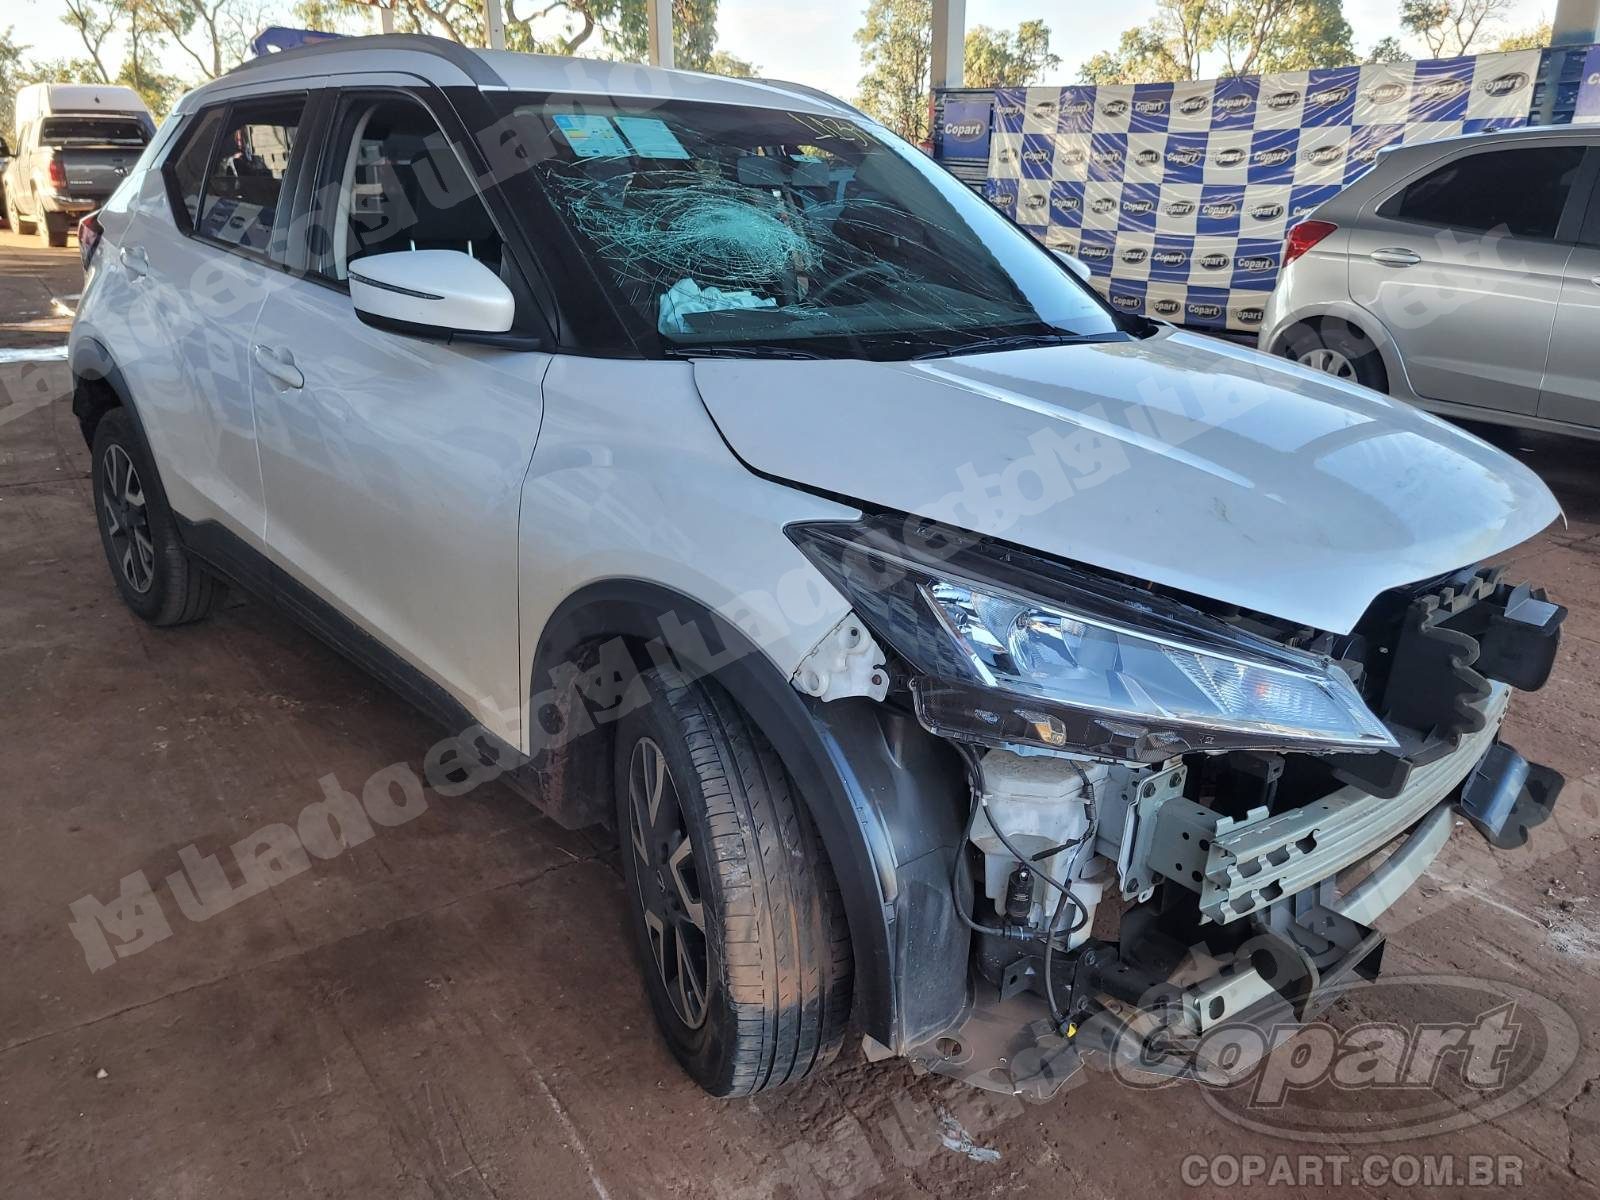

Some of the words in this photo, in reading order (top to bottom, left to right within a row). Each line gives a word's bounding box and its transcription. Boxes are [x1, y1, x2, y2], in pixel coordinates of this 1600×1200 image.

[1477, 77, 1522, 92] Copart
[1062, 103, 1089, 113] Copart
[1135, 102, 1163, 112] Copart
[1217, 97, 1250, 107] Copart
[945, 122, 980, 137] Copart
[1023, 151, 1048, 161] Copart
[1167, 151, 1197, 164] Copart
[1254, 151, 1288, 163] Copart
[1051, 198, 1077, 208] Copart
[1122, 201, 1151, 212] Copart
[1202, 203, 1234, 215] Copart
[1081, 247, 1108, 257] Copart
[1154, 252, 1183, 264] Copart
[1238, 259, 1270, 271] Copart
[1113, 295, 1138, 307] Copart
[1188, 304, 1217, 317] Copart
